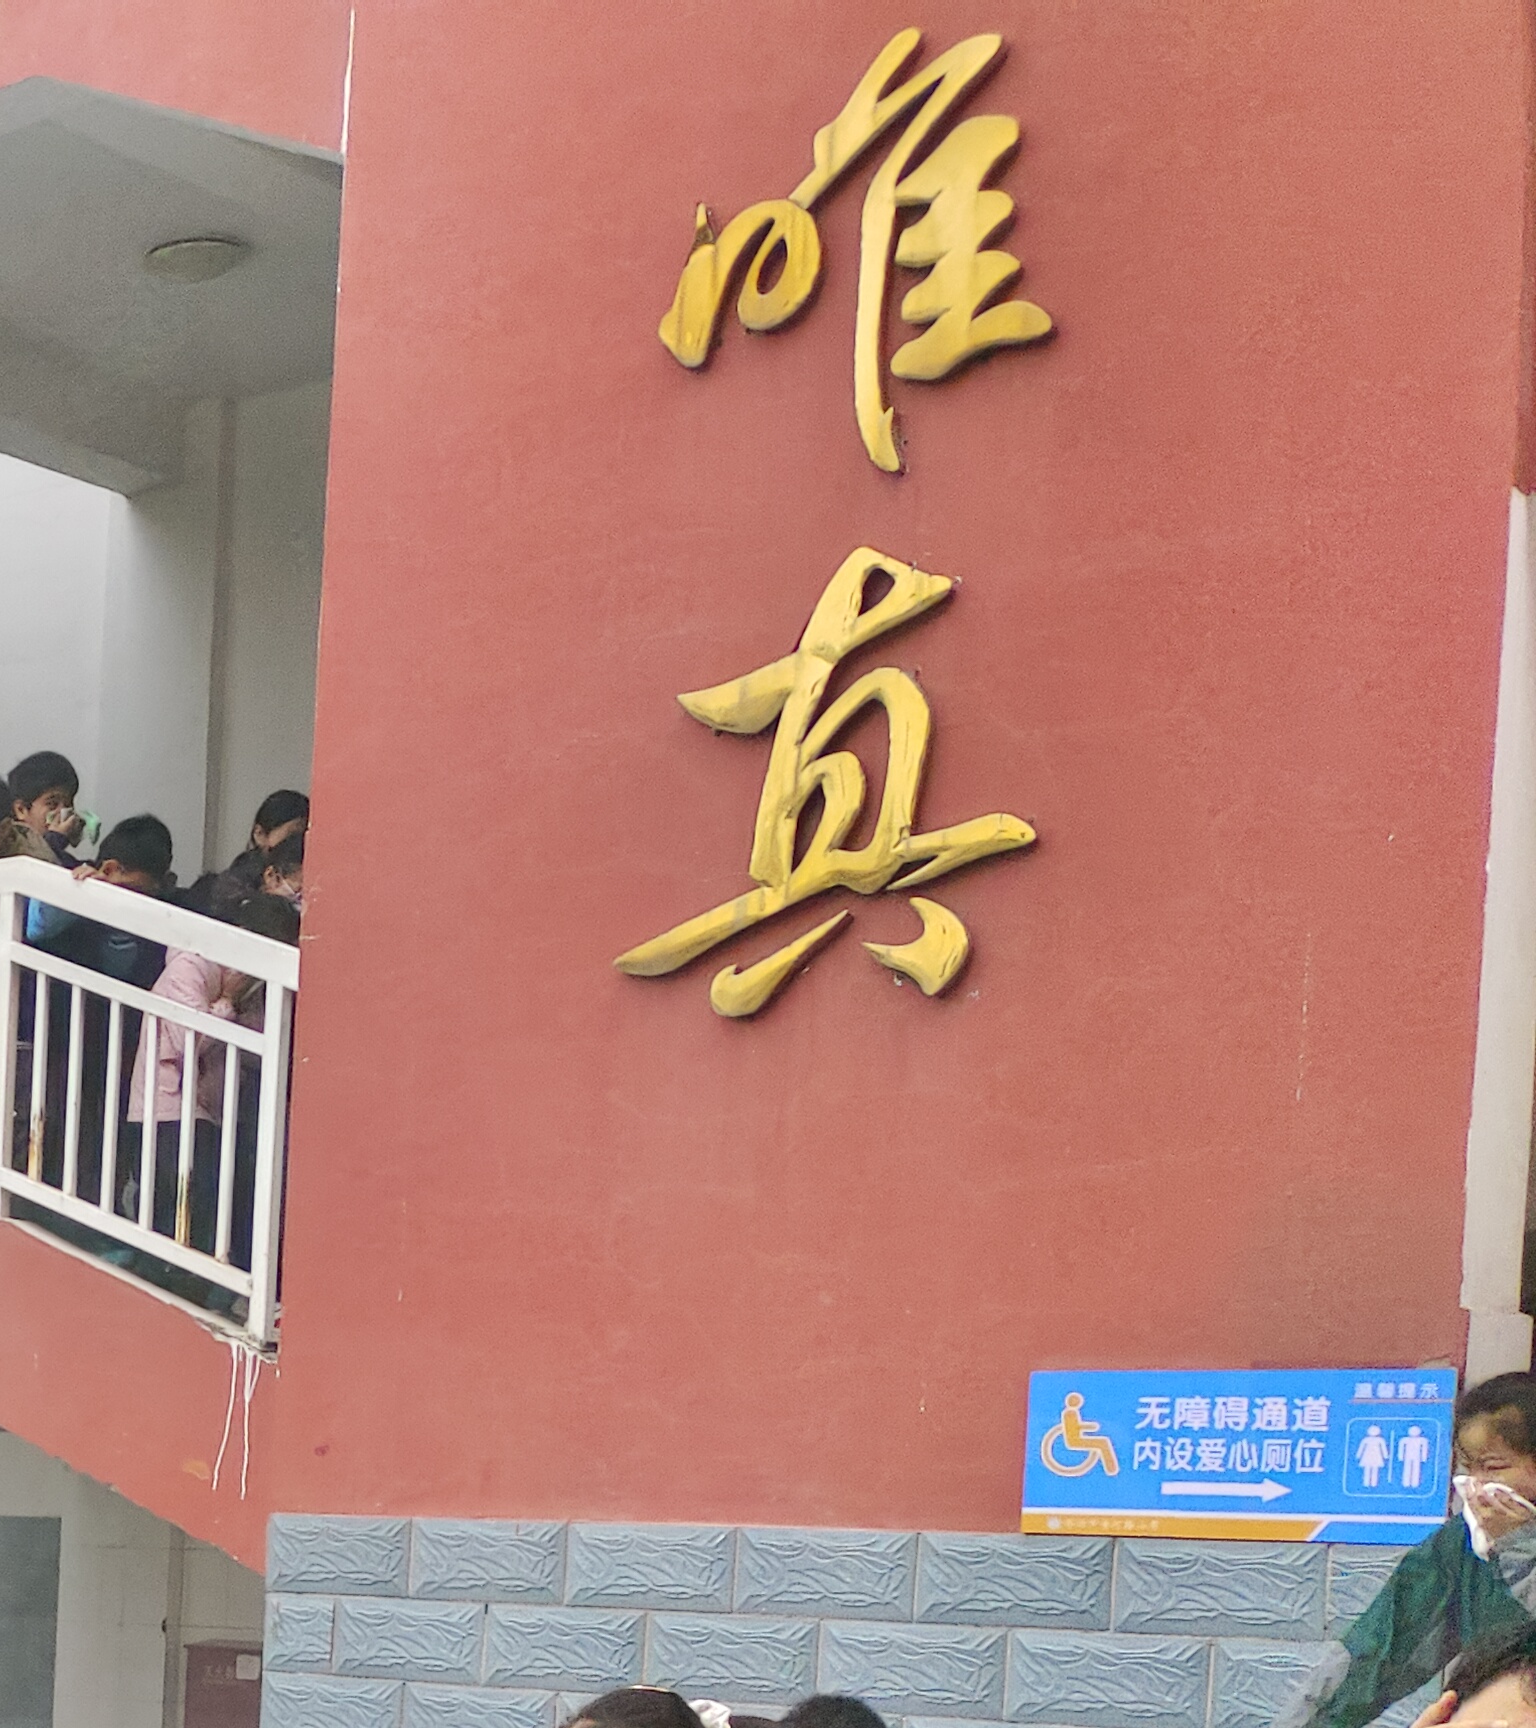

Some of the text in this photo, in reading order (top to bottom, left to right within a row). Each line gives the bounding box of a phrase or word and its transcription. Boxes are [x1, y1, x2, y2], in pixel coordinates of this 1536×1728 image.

[1134, 1396, 1331, 1432] 无障碍通道
[1132, 1436, 1326, 1474] 内设爱心厕位
